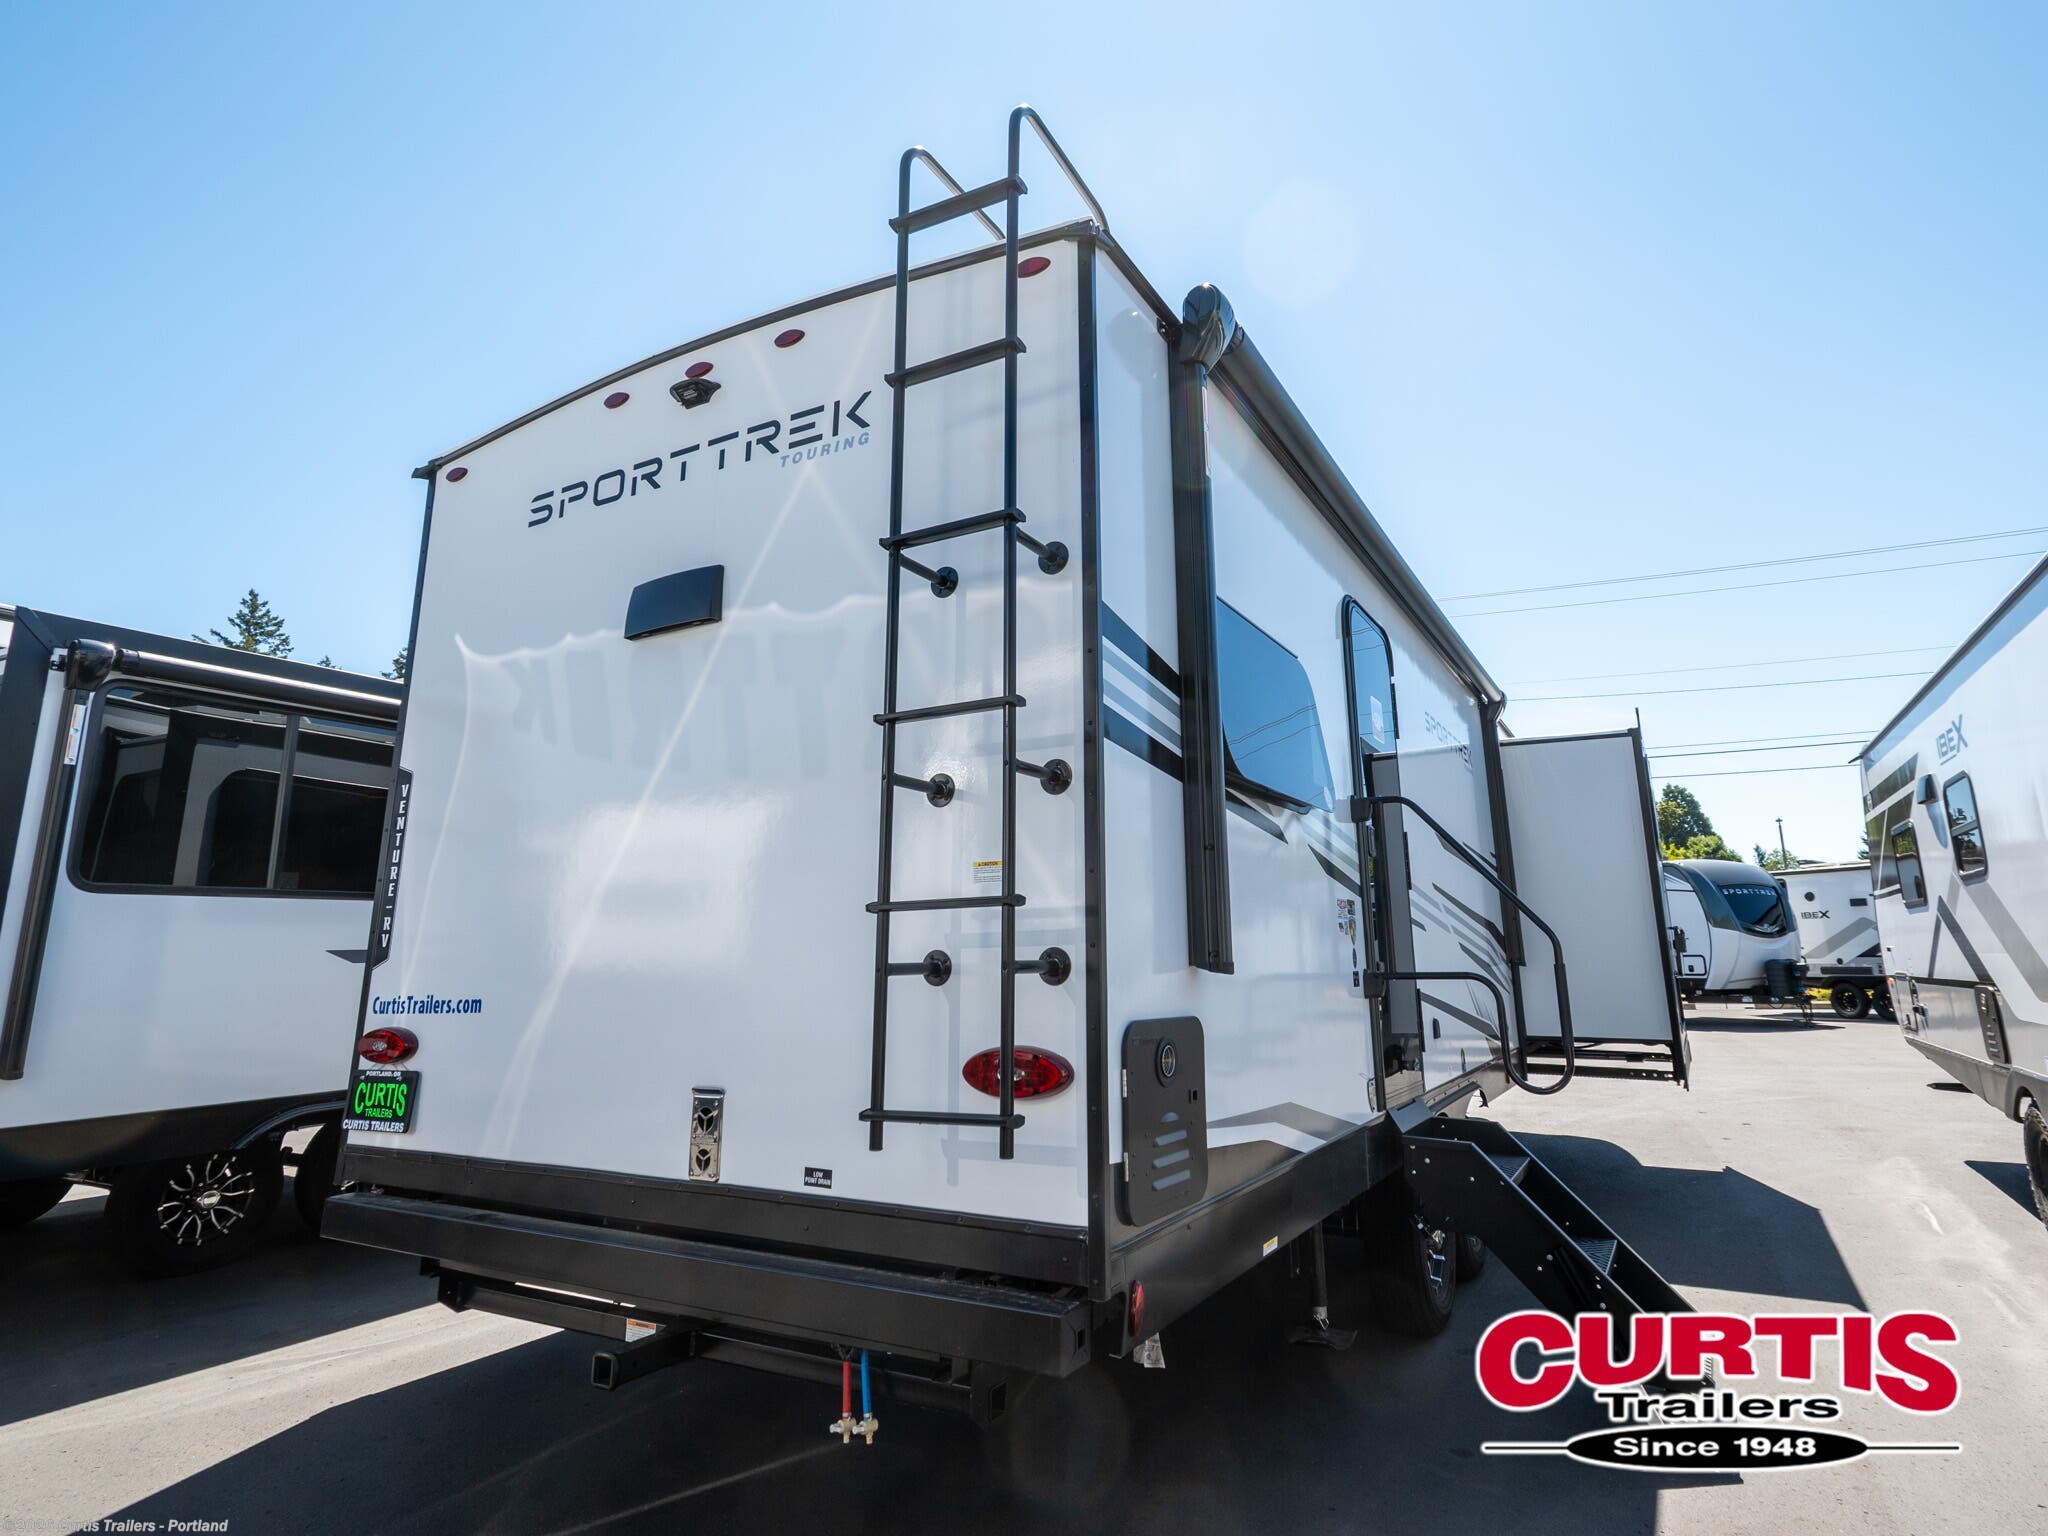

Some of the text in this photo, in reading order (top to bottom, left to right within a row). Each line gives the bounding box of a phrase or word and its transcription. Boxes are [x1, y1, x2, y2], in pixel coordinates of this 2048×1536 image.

[528, 391, 872, 527] SPORTTREK
[780, 432, 870, 467] TOURING
[1936, 714, 1968, 760] IBEX
[1801, 910, 1831, 920] IBEX
[372, 995, 482, 1014] CurtisTrailers.com
[354, 1082, 408, 1117] CURTIS
[365, 1108, 393, 1118] TRAILERS
[343, 1119, 404, 1132] CURTIS TRAILERS
